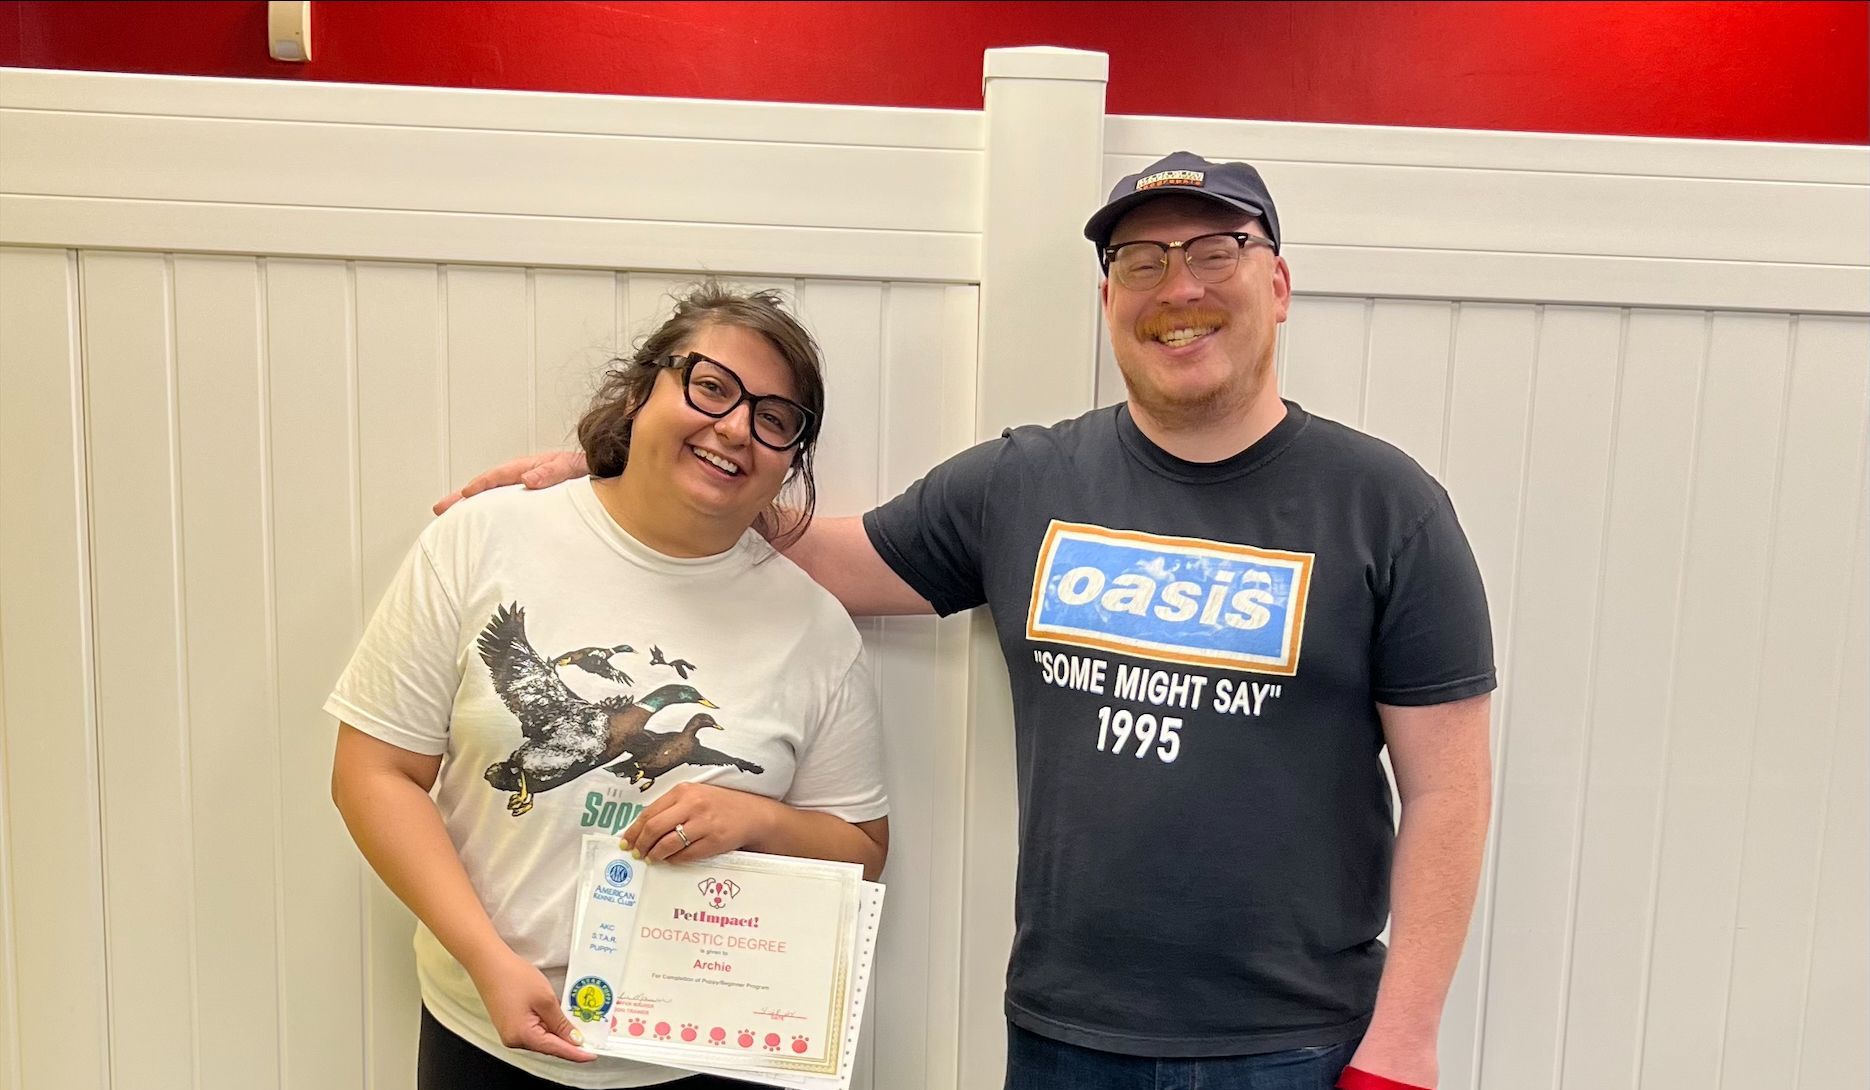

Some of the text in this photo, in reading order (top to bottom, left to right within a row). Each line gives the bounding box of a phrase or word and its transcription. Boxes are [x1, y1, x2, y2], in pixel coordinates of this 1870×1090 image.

[1057, 566, 1274, 630] oasis
[1033, 650, 1282, 716] "SOME MIGHT SAY"
[1096, 706, 1183, 764] 1995
[595, 885, 636, 900] AMERICAN
[599, 923, 616, 931] AKC
[673, 908, 760, 928] PetImpact!
[641, 926, 787, 953] DOGTASTIC DEGREE
[693, 959, 732, 973] Archie
